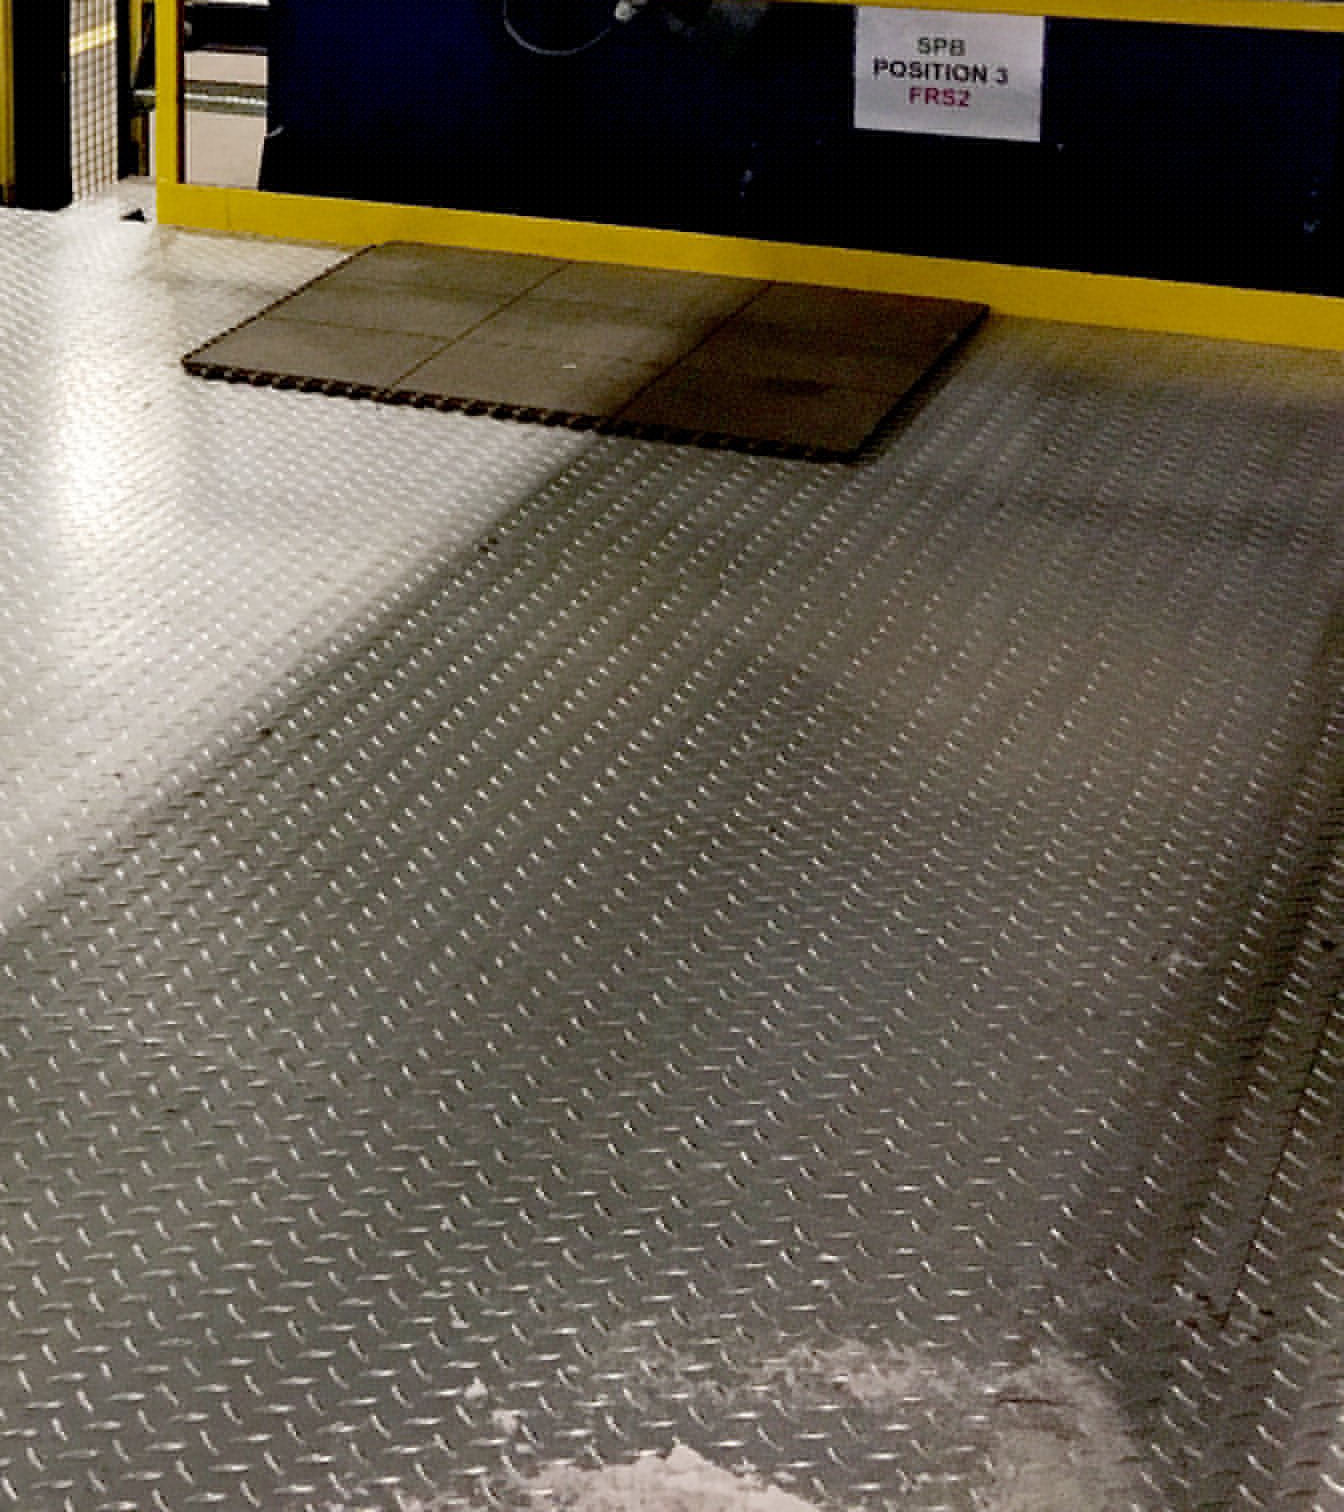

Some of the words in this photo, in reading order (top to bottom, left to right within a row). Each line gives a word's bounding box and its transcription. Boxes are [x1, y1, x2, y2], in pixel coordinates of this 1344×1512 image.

[873, 57, 988, 85] POSITION
[994, 67, 1009, 85] 3
[909, 87, 971, 108] FRS2
